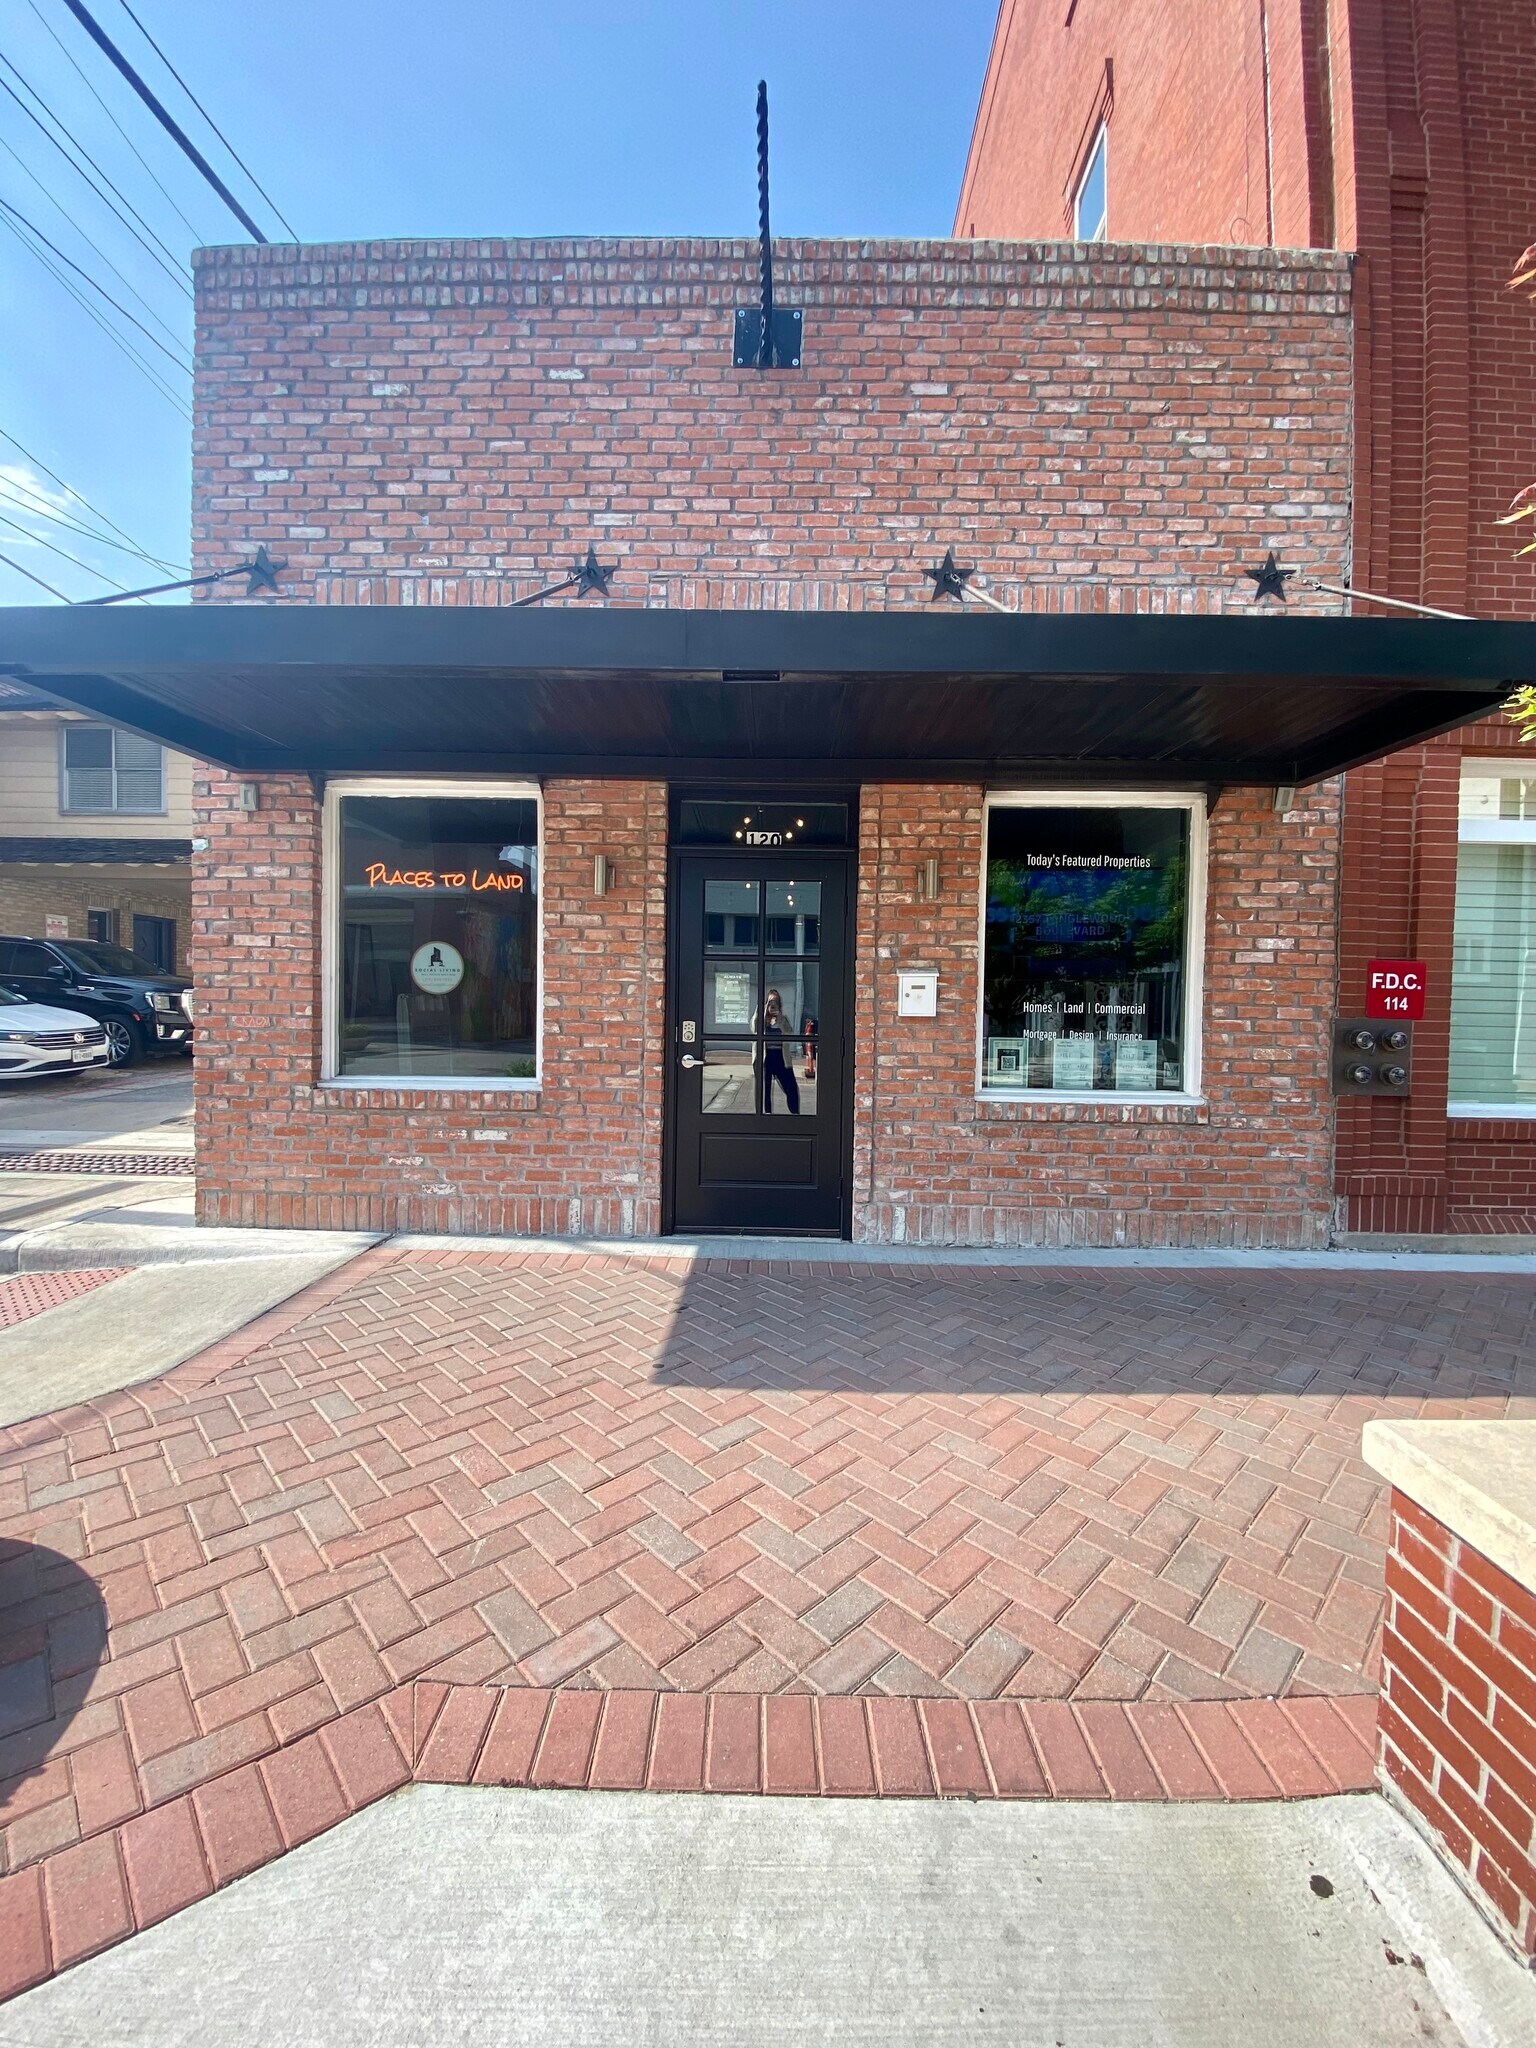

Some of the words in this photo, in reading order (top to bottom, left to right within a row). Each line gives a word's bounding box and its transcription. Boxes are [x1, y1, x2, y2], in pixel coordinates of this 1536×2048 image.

[749, 833, 781, 846] 120
[1026, 854, 1061, 869] Today's
[1062, 854, 1102, 867] Featured
[1104, 855, 1151, 869] Properties
[1036, 925, 1106, 936] BOULEVARD
[1372, 973, 1422, 990] F.D.C.
[1023, 1001, 1053, 1014] Homes
[1063, 1002, 1084, 1014] Land
[1094, 1002, 1146, 1015] Commercial
[1383, 996, 1409, 1011] 114
[1023, 1029, 1057, 1042] Mortgage
[1069, 1030, 1094, 1042] Design
[1106, 1031, 1143, 1042] Insurance
